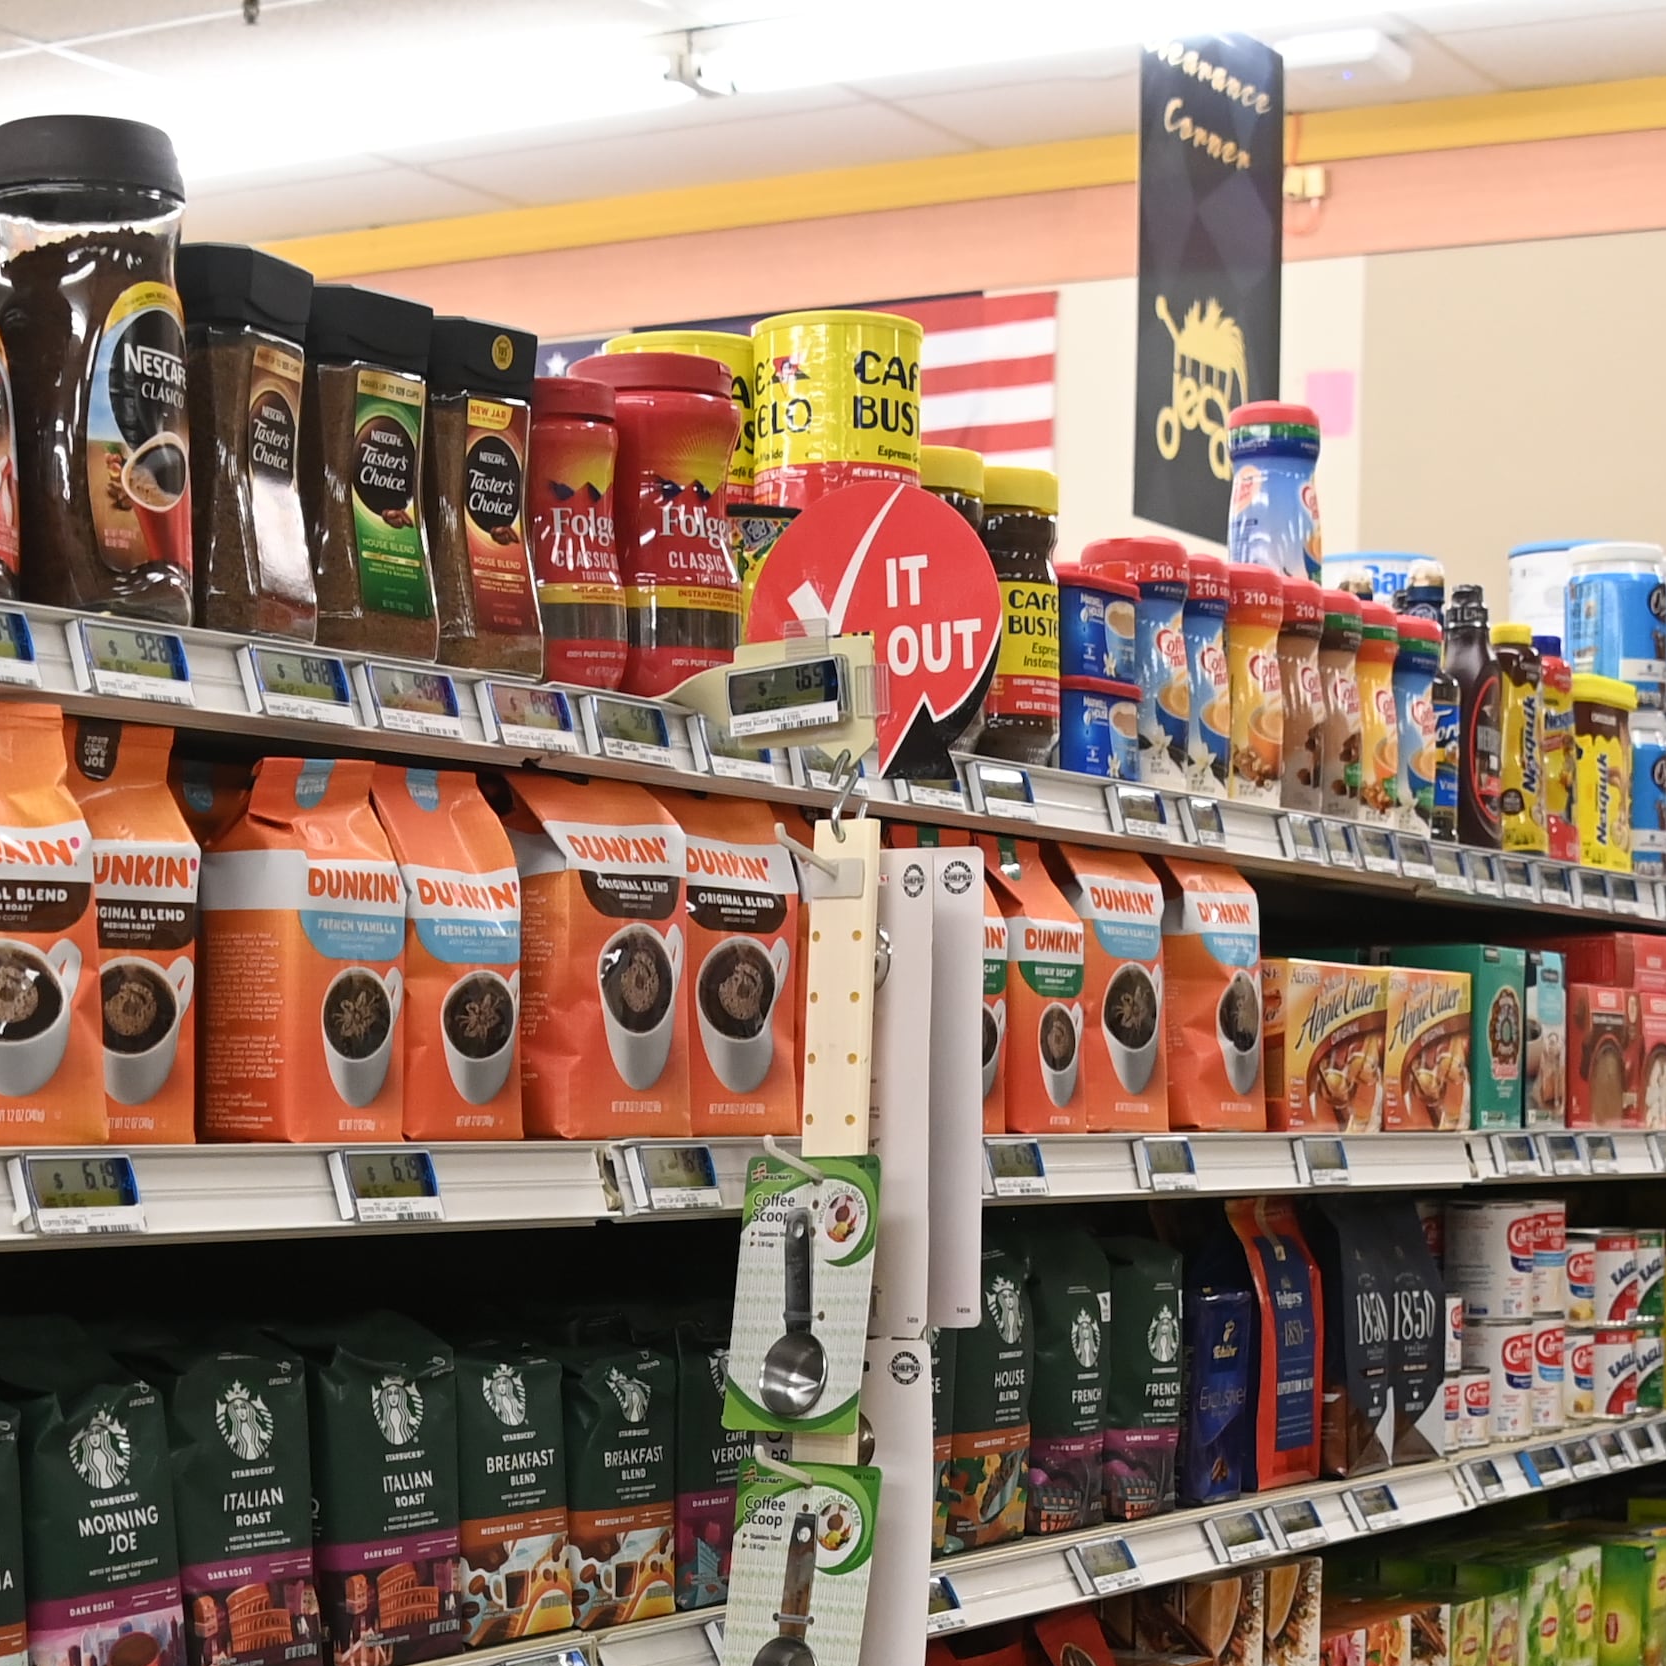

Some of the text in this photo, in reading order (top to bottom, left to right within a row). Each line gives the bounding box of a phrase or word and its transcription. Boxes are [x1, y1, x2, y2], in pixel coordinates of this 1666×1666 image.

[252, 419, 290, 452] Taster's
[360, 446, 409, 477] Taster's
[468, 470, 515, 498] Taster's
[886, 555, 929, 607] IT
[887, 618, 982, 677] OUT
[16, 886, 69, 904] BLEND
[307, 865, 402, 905] DUNKIN'
[697, 892, 774, 909] ORIGINAL BLEND
[1090, 884, 1156, 917] DUNKIN'
[317, 918, 397, 935] FRENCH VANILLA
[1024, 927, 1083, 954] DUNKIN'
[1392, 1289, 1434, 1340] 1850
[994, 1369, 1025, 1389] HOUSE
[999, 1388, 1019, 1402] BLEND
[1072, 1388, 1102, 1403] FRENCH
[485, 1448, 555, 1475] BREAKFAST
[603, 1445, 664, 1469] BREAKFAST
[382, 1470, 433, 1494] ITALIAN
[510, 1472, 536, 1487] BLEND
[222, 1486, 284, 1513] ITALIAN
[745, 1495, 786, 1512] Coffee
[77, 1505, 159, 1538] MORNING
[235, 1511, 272, 1527] ROAST
[744, 1509, 783, 1529] Scoop
[107, 1533, 137, 1556] JOE
